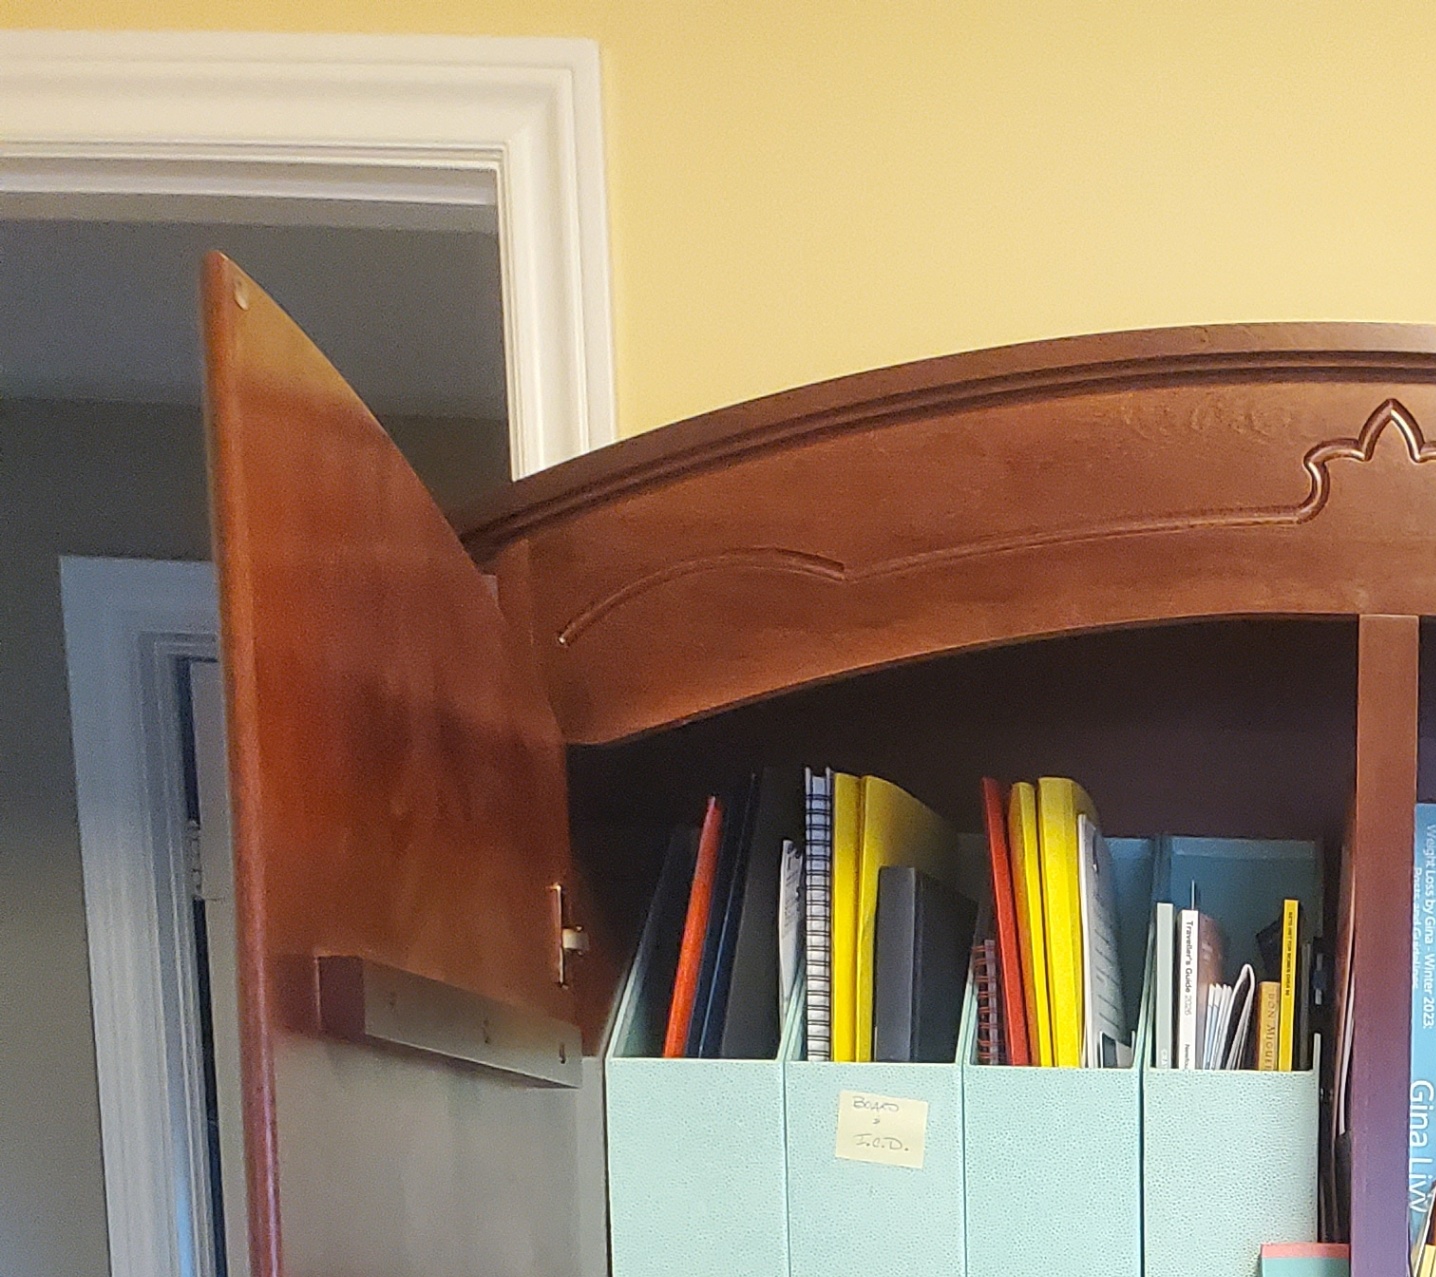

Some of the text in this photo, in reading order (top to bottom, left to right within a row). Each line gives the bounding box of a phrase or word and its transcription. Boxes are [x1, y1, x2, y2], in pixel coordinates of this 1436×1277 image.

[1423, 824, 1436, 867] Weight
[1425, 869, 1436, 896] Loss
[1421, 899, 1436, 914] by
[1185, 920, 1194, 965] Traveller's
[1424, 916, 1436, 944] Gina
[1184, 967, 1193, 993] Guide
[1423, 953, 1436, 994] Winter
[1409, 1080, 1434, 1148] Gina
